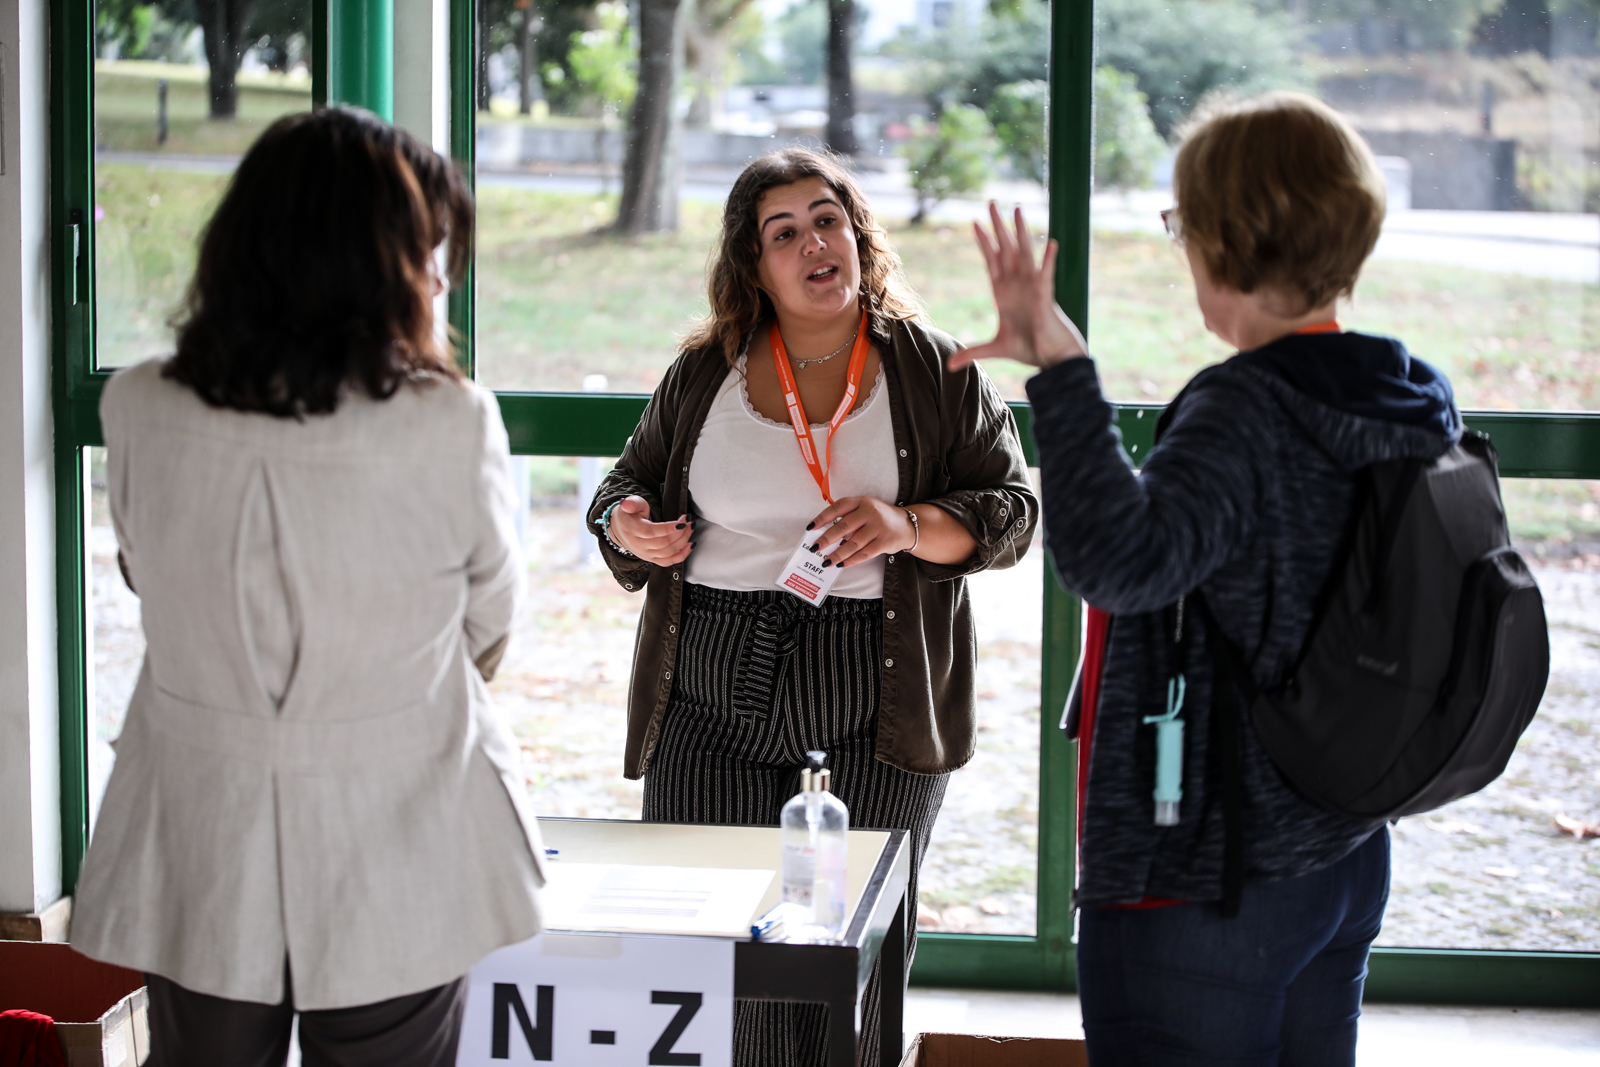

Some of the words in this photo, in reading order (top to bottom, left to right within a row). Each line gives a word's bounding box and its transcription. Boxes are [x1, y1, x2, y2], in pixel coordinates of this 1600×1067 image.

[804, 561, 824, 575] STAFF
[787, 580, 796, 588] SEM
[795, 584, 815, 598] BARREIRAS
[797, 576, 820, 591] BOUNDARIES
[491, 982, 555, 1062] N
[589, 1029, 616, 1045] -
[648, 989, 704, 1067] Z
